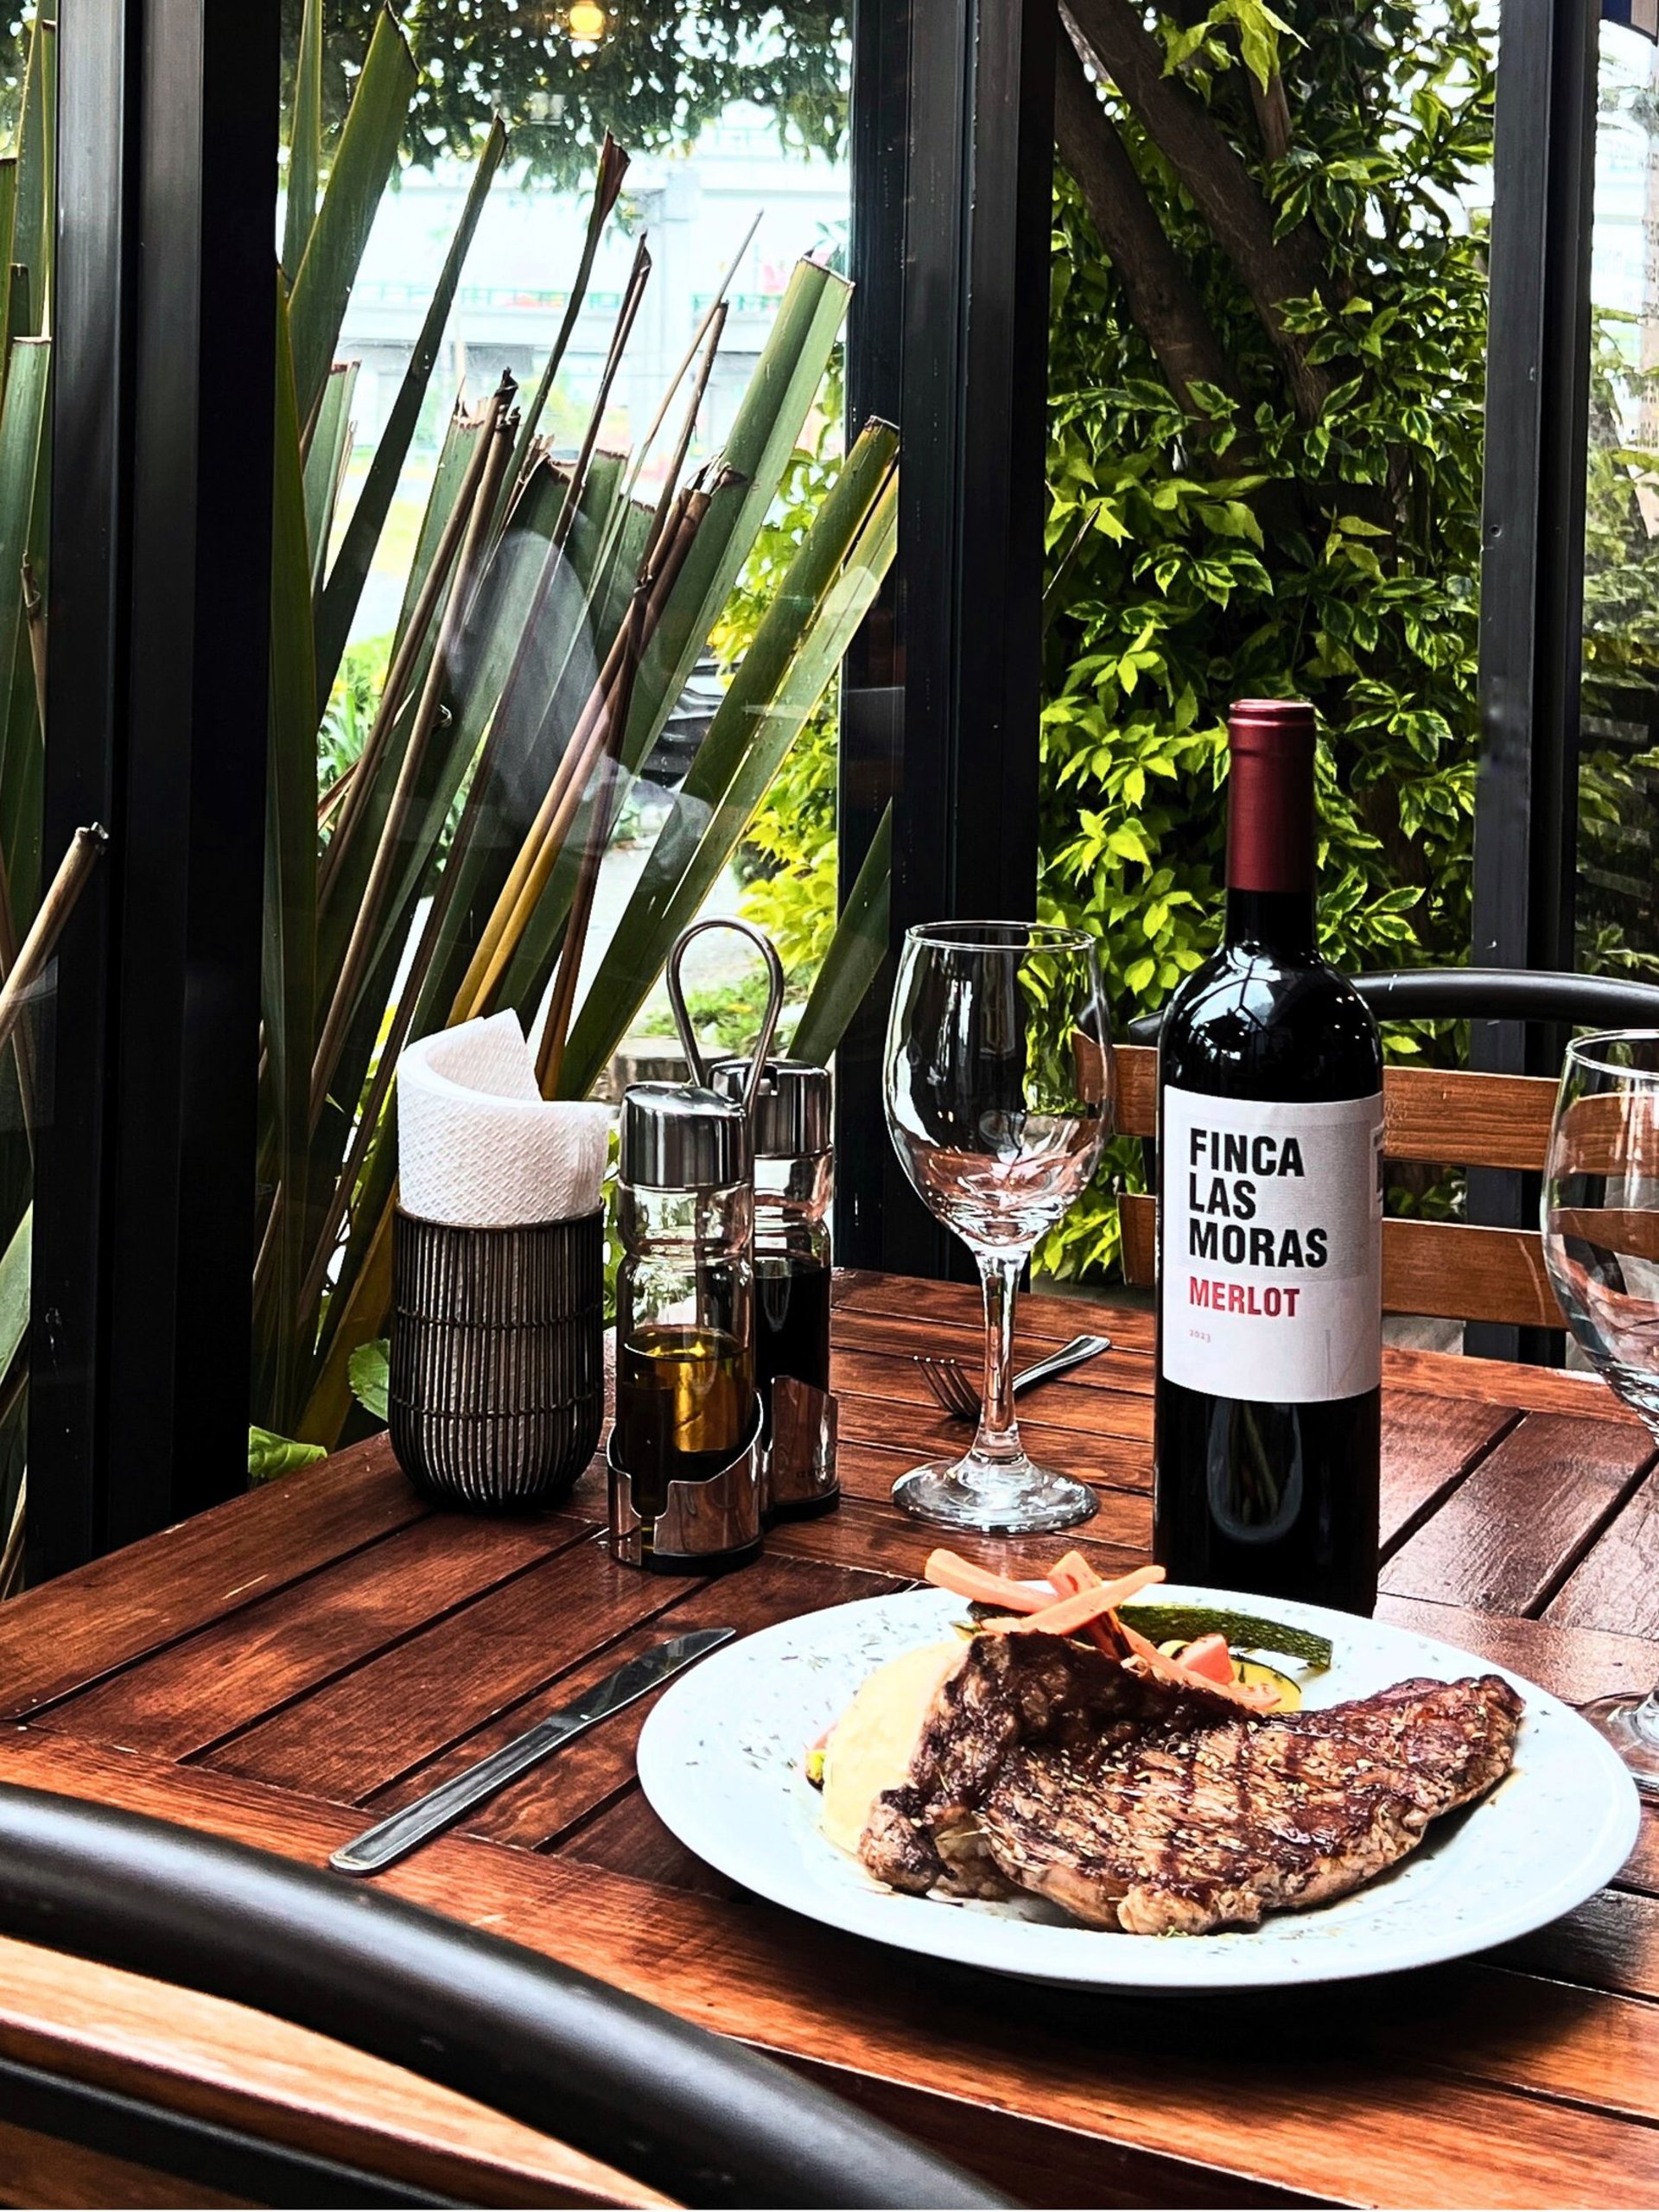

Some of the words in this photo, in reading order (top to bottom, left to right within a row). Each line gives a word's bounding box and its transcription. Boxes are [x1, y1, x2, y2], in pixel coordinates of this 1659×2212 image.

[1190, 1128, 1305, 1177] FINCA
[1189, 1172, 1256, 1220] LAS
[1189, 1217, 1328, 1268] MORAS
[1189, 1276, 1300, 1317] MERLOT
